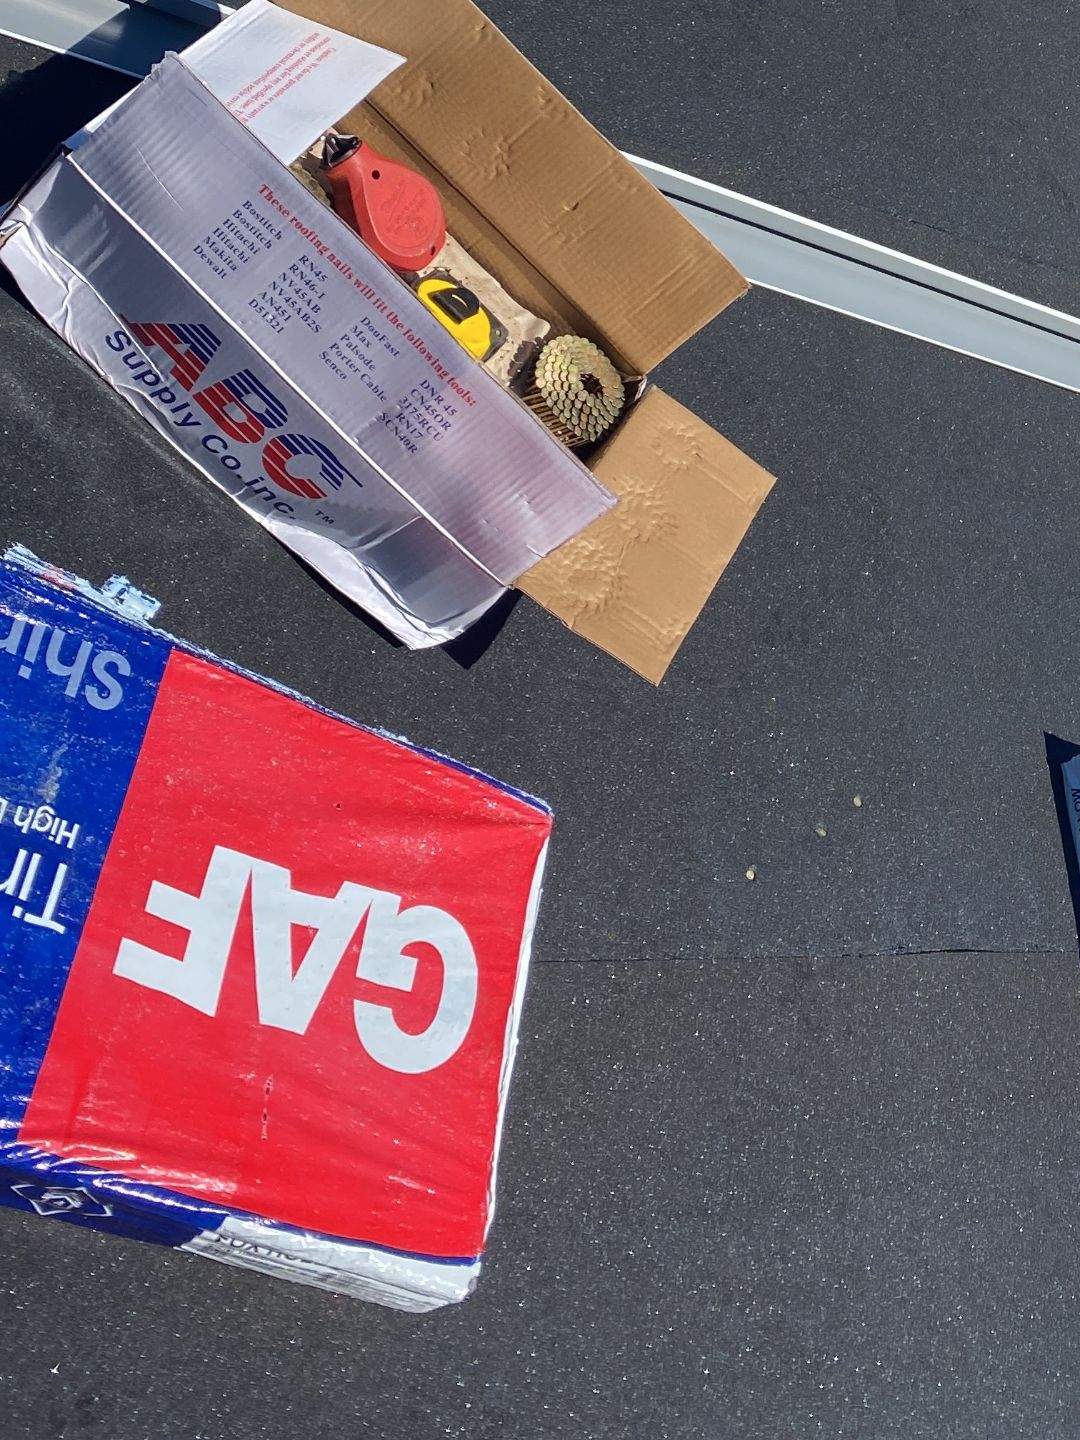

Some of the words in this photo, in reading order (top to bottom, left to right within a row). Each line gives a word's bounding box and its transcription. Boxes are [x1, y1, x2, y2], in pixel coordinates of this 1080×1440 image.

[192, 244, 228, 280] Dewalt
[202, 235, 239, 272] Makita
[318, 350, 349, 380] Senco
[212, 226, 250, 264] Hitachi
[267, 280, 322, 334] NV45AB2S
[328, 341, 362, 374] Porter
[358, 372, 389, 402] Cable
[394, 412, 424, 440] RN17
[222, 217, 260, 255] Hitachi
[277, 271, 321, 314] NV45AB
[231, 208, 274, 250] Bostitch
[349, 325, 373, 348] Max
[241, 199, 283, 240] Bostitch
[298, 254, 328, 283] RN45
[419, 378, 445, 404] DNR
[257, 183, 291, 218] These
[288, 214, 330, 256] roofing
[326, 251, 355, 280] nails
[351, 277, 376, 301] will
[372, 298, 388, 314] fit
[385, 310, 405, 331] the
[398, 328, 452, 380] following
[446, 376, 478, 407] tools:
[103, 329, 204, 428] Supply
[120, 315, 363, 499] ABC
[15, 803, 80, 849] High
[113, 845, 479, 1073] GAF
